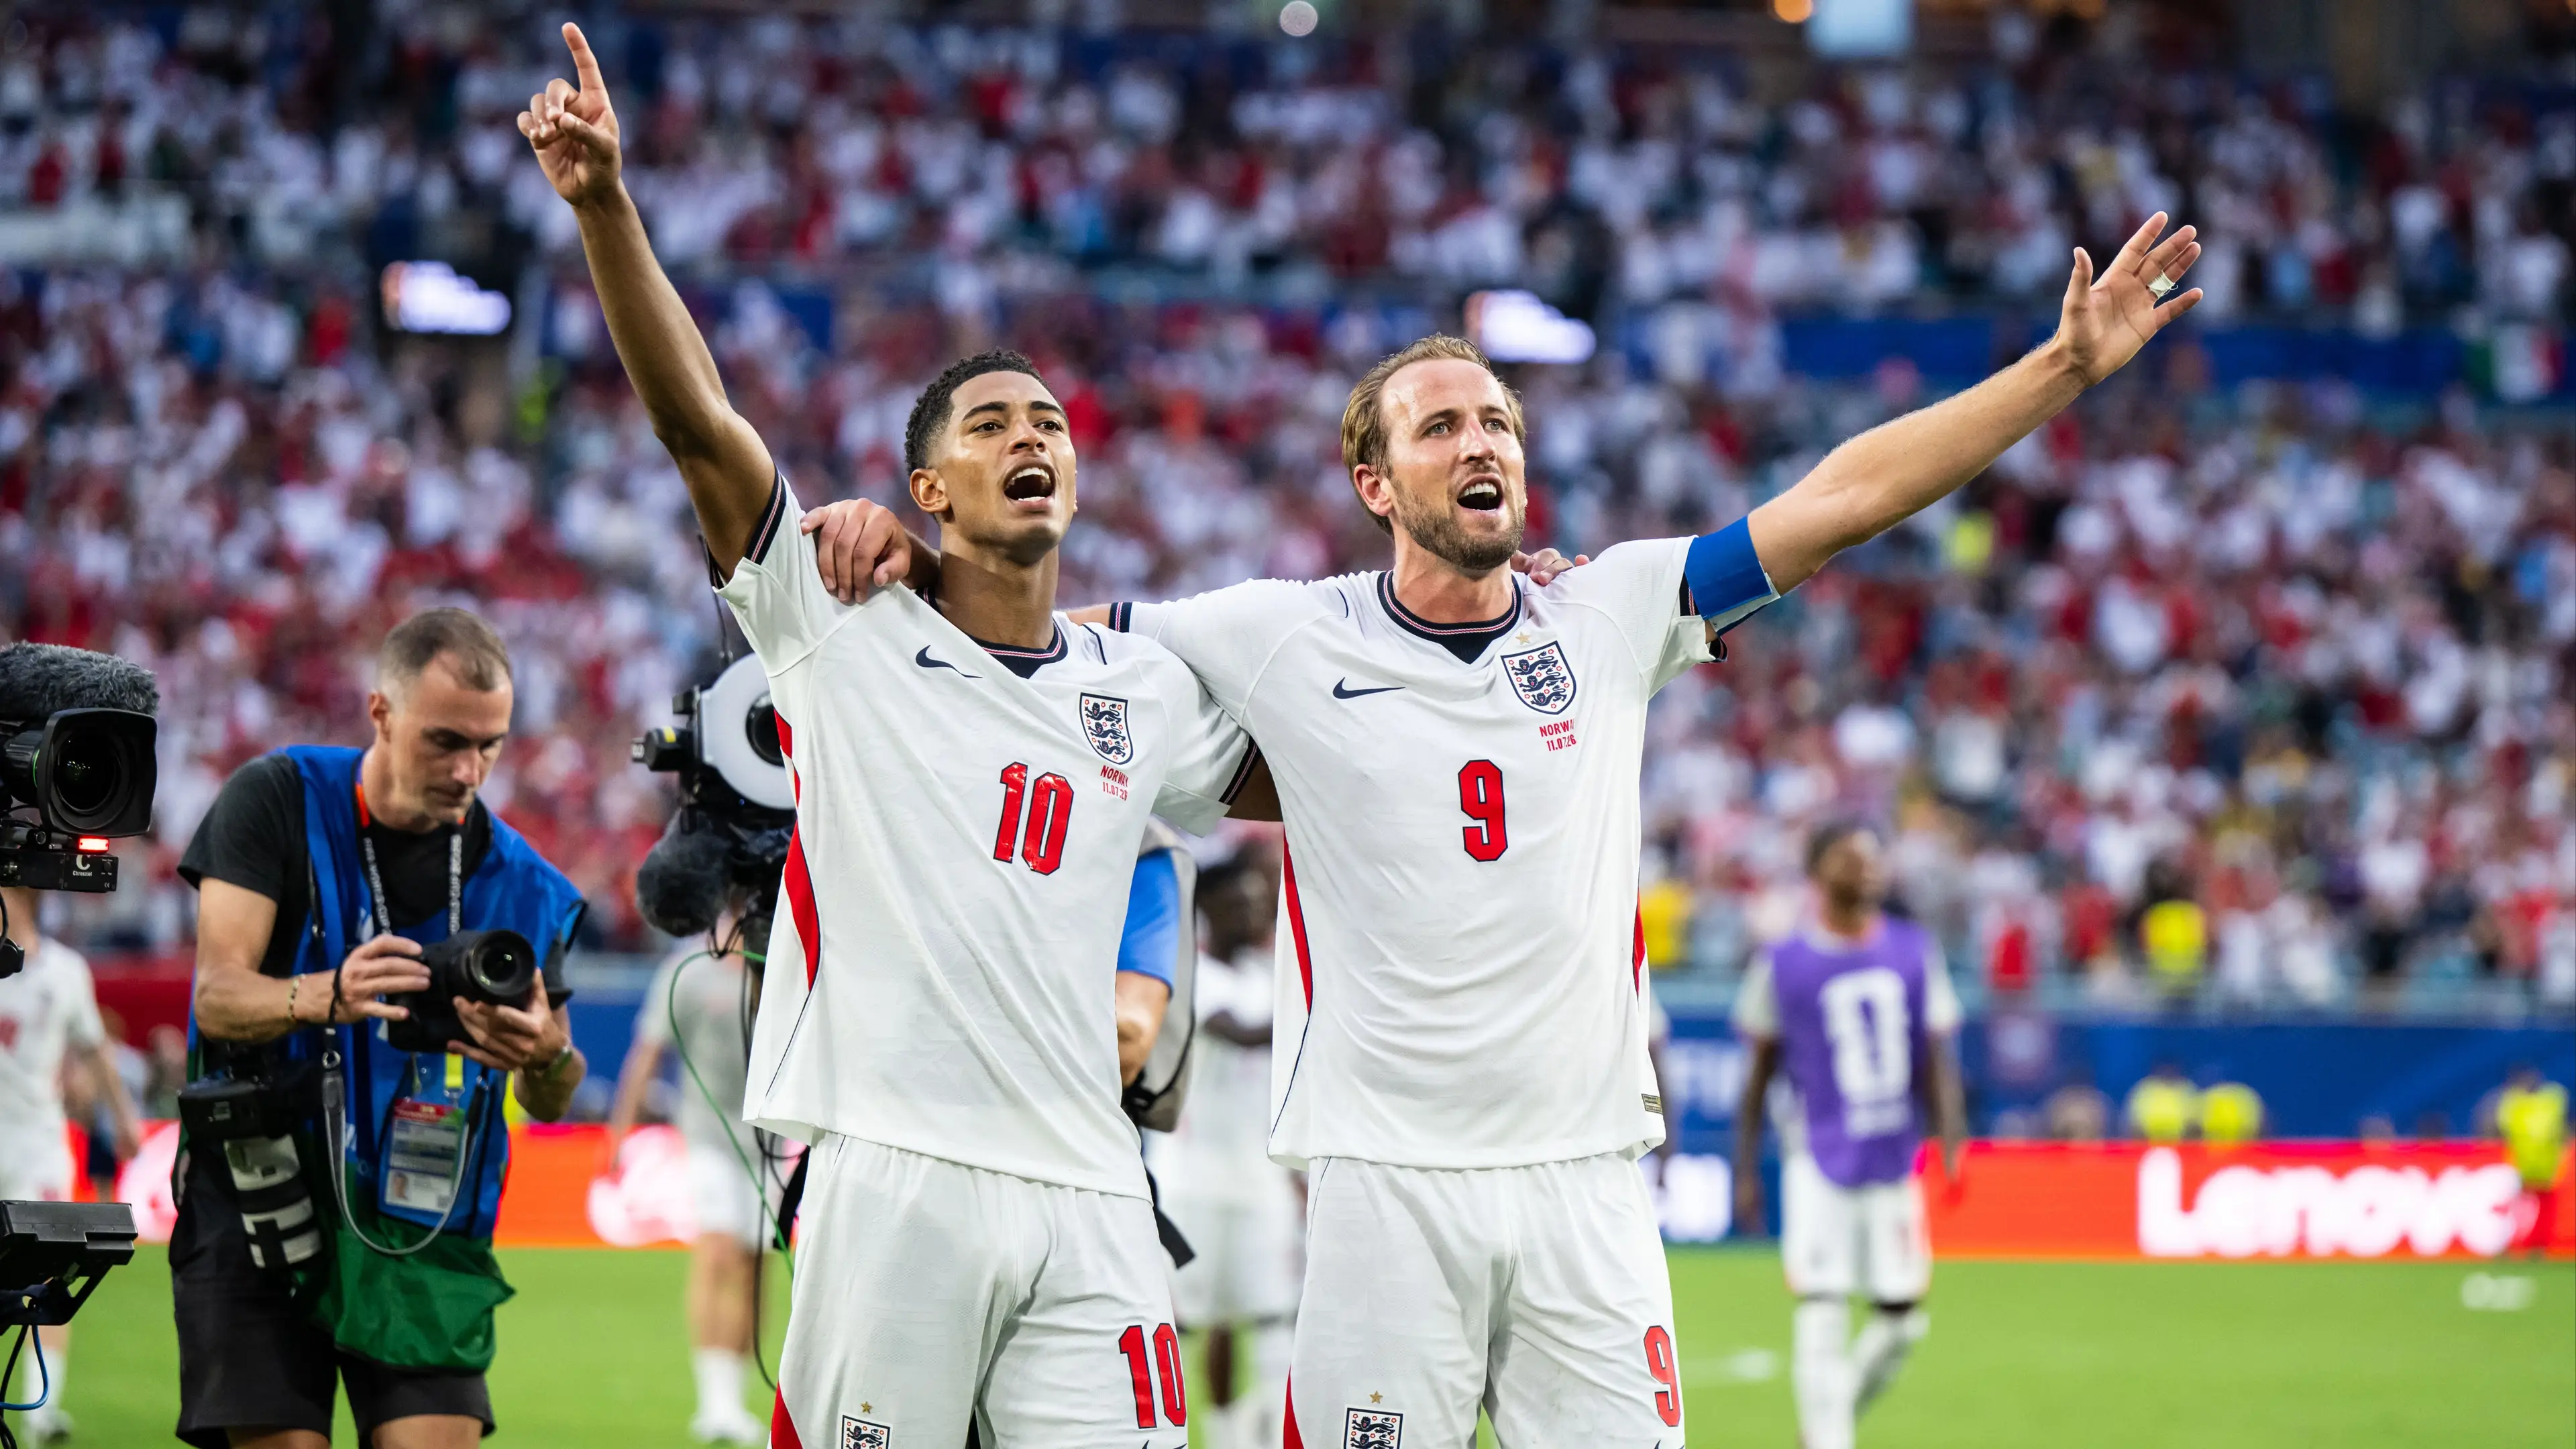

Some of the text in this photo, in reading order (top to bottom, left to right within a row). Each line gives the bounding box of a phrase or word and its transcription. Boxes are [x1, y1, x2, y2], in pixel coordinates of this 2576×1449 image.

[1100, 765, 1128, 787] NORWAY
[1546, 734, 1576, 751] 11.07.26
[993, 761, 1075, 876] 10
[1457, 759, 1508, 862] 9
[1118, 1323, 1187, 1429] 10
[1644, 1325, 1681, 1427] 9
